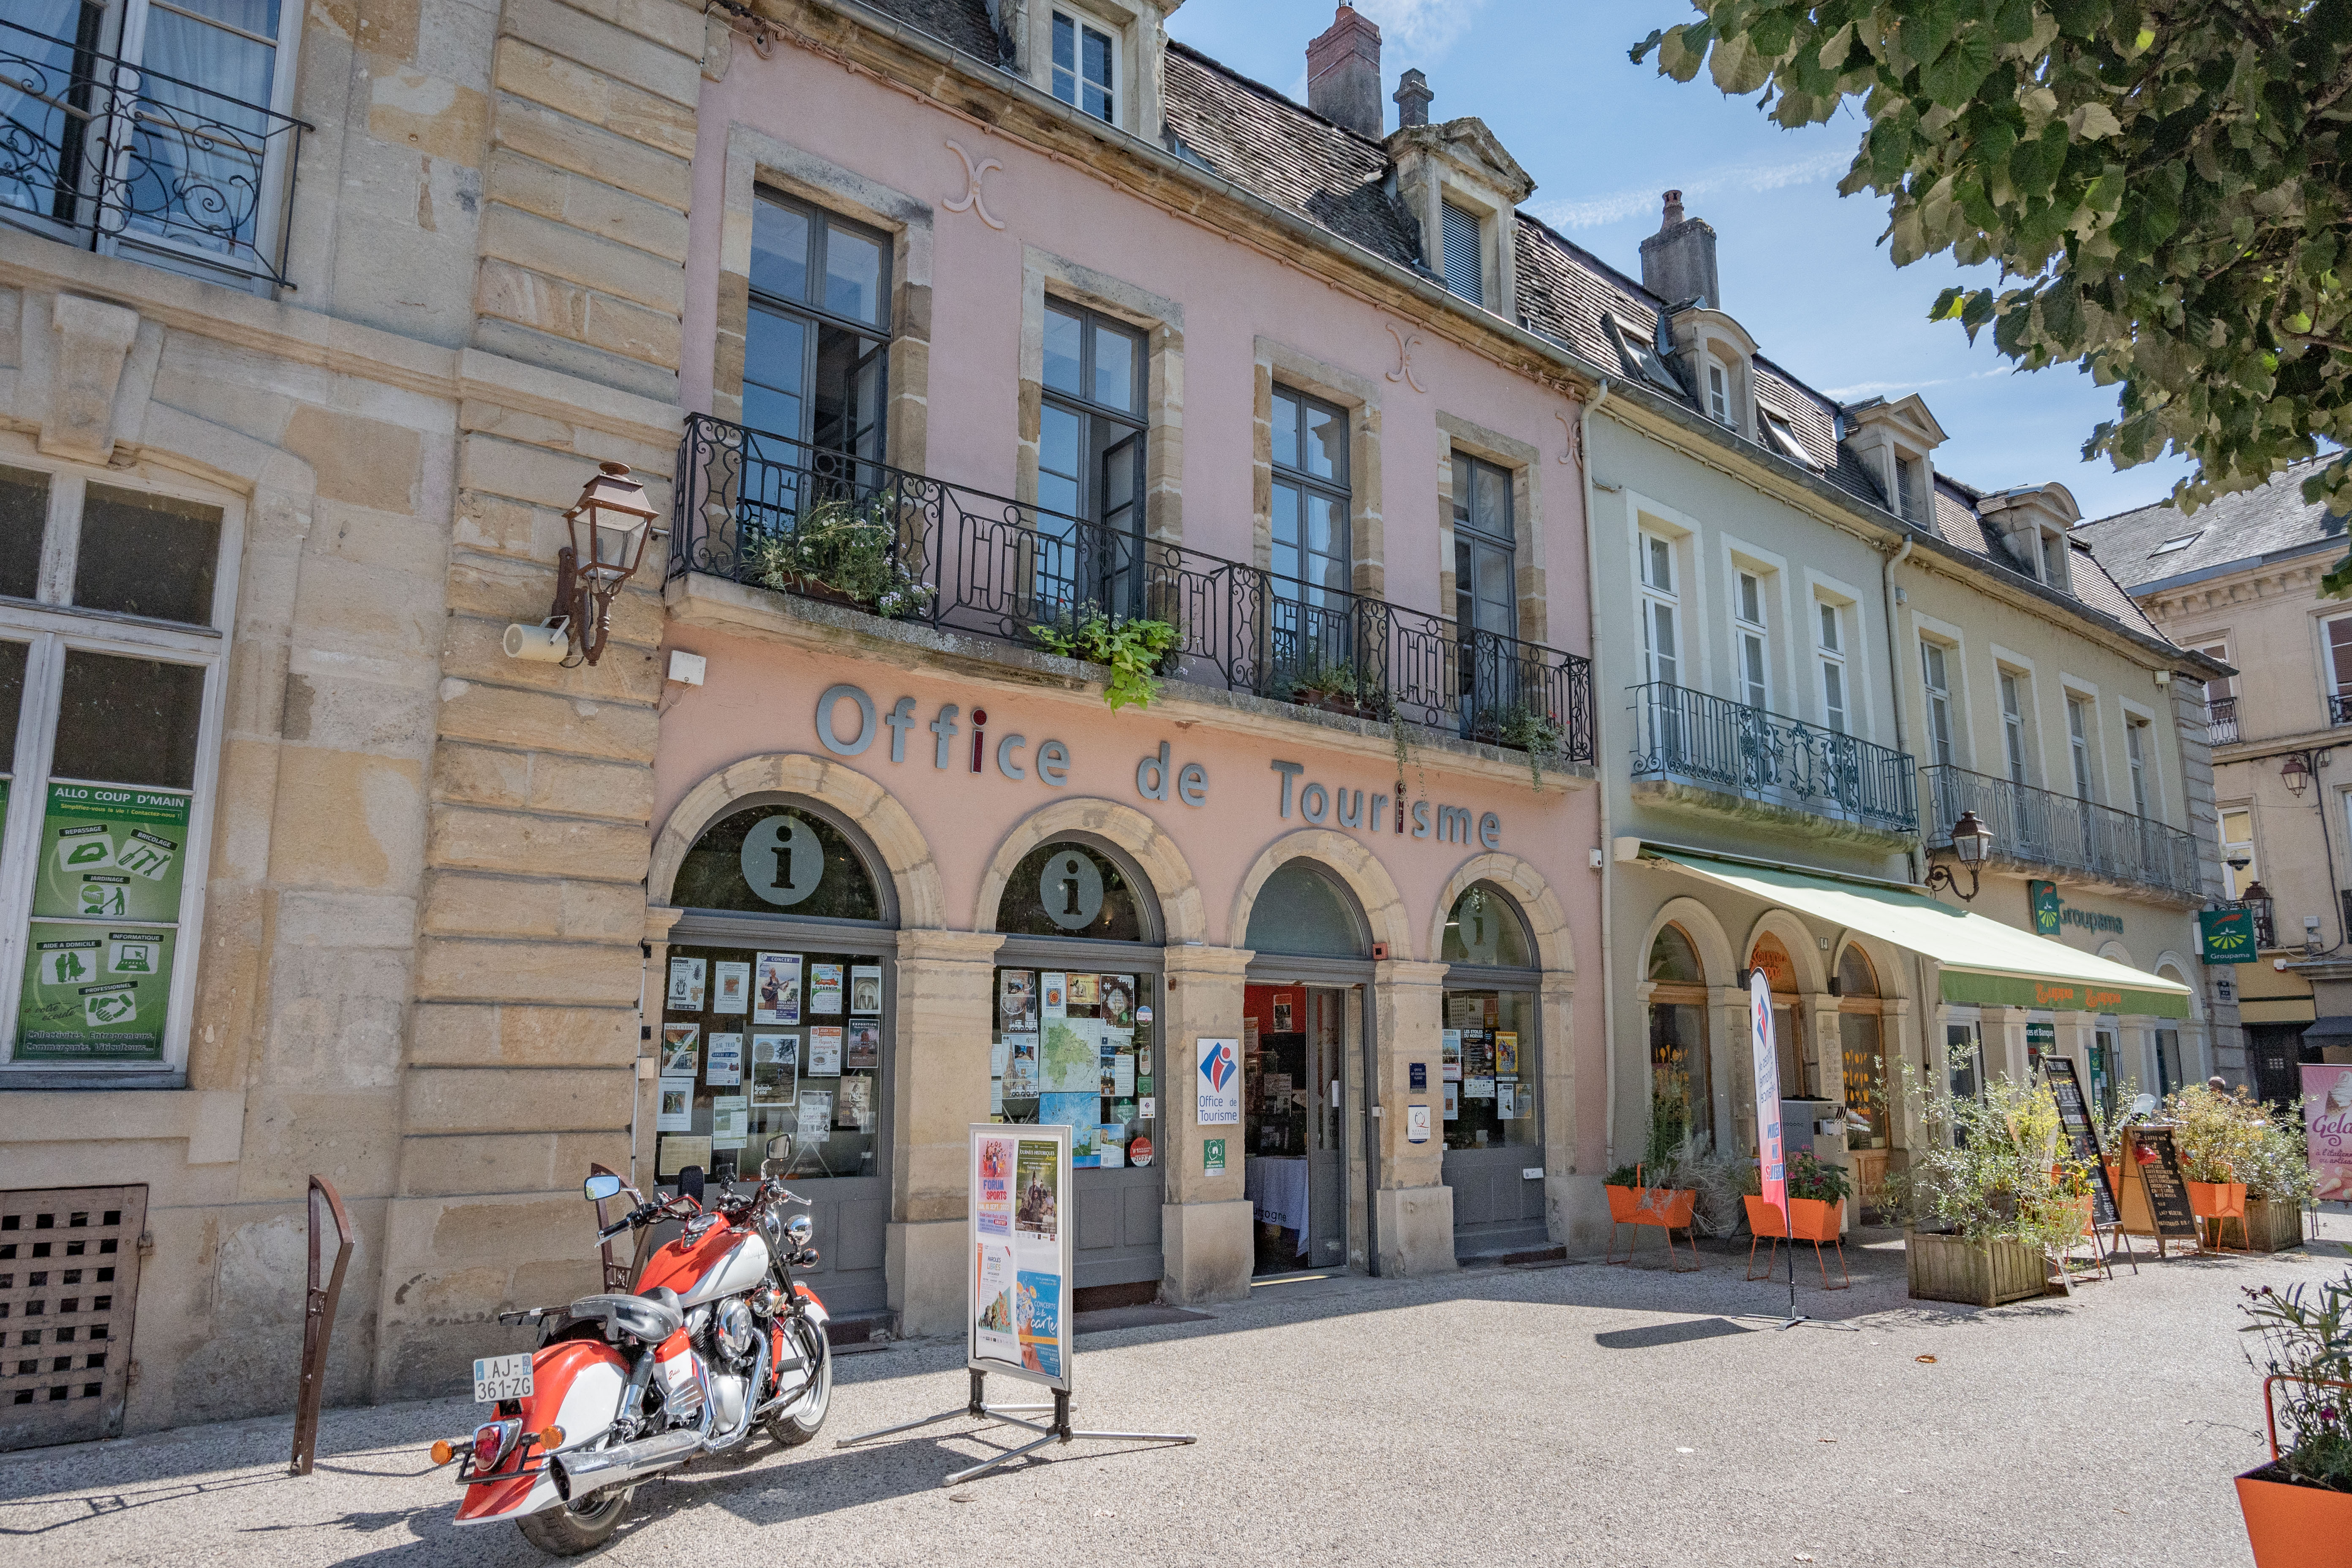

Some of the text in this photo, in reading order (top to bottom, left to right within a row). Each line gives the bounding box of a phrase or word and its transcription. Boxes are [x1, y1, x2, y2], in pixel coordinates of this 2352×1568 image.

[816, 684, 1501, 850] Office de Tourisme
[55, 787, 185, 807] ALLO COUP D'MAIN
[61, 803, 105, 812] Simplifiez-vous
[131, 809, 175, 818] Contactez-nous
[65, 826, 102, 835] REPASSAGE
[137, 832, 172, 847] BRICOLAGE
[85, 983, 132, 993] PROFESSIONNEL
[27, 1031, 155, 1040] Collectivités, Entrepreneurs,
[2039, 1028, 2054, 1038] Banque
[26, 1043, 91, 1052] Commerçants,
[1199, 1096, 1237, 1107] Office de
[1200, 1110, 1237, 1122] Tourisme
[983, 1180, 1004, 1190] FORUM
[986, 1191, 1007, 1200] SPORTS
[987, 1263, 1001, 1271] LIBRES
[1034, 1301, 1056, 1310] CONCERTS
[1036, 1308, 1047, 1317] à la
[1030, 1315, 1058, 1334] carte
[492, 1358, 519, 1378] AJ-
[478, 1377, 531, 1400] 361-ZG
